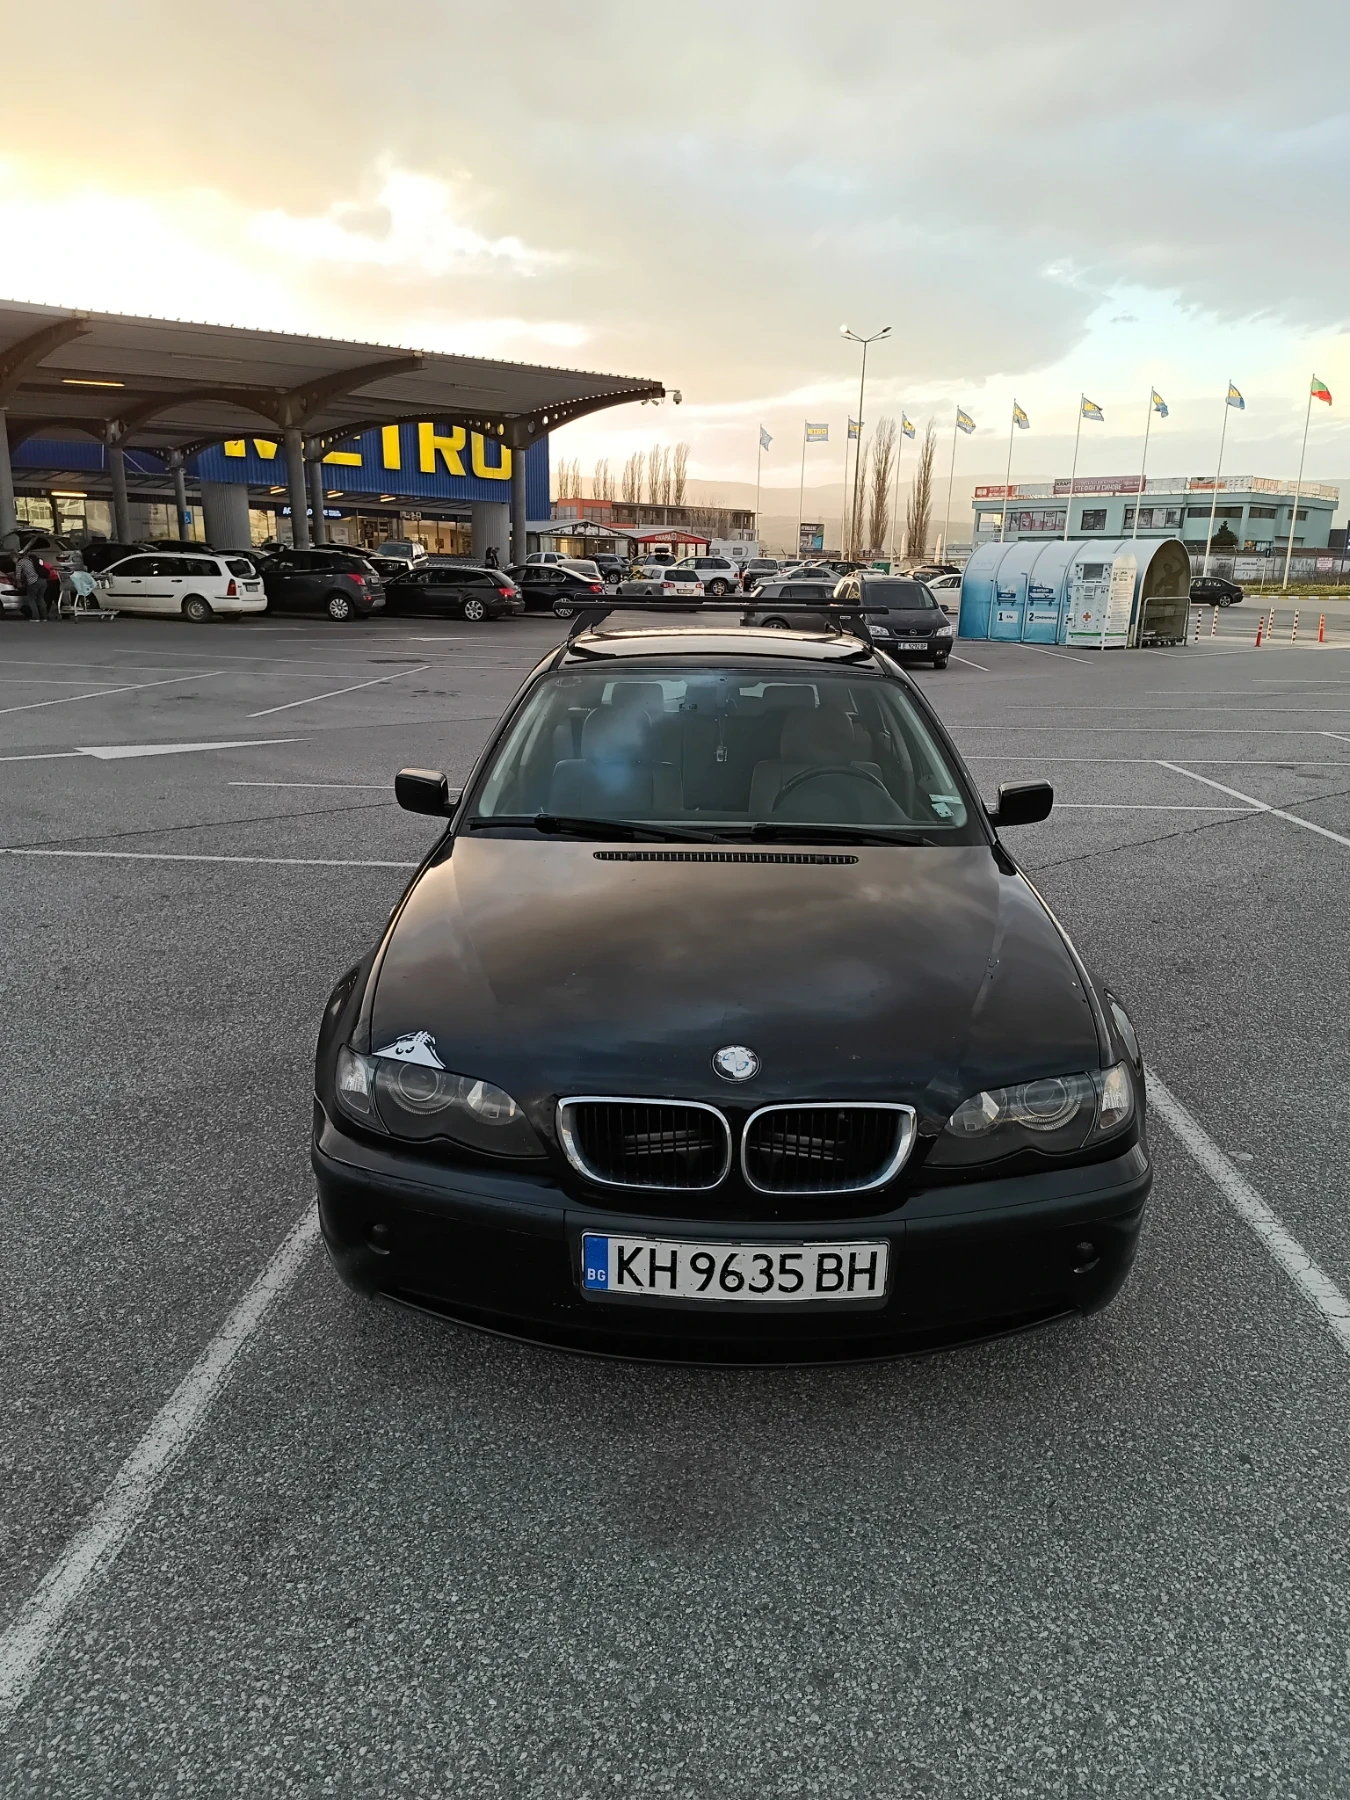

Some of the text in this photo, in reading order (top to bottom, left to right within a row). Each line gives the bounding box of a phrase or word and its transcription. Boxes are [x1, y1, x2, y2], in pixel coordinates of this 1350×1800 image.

[998, 612, 1003, 621] 1
[1028, 612, 1034, 622] 2
[587, 1268, 606, 1281] BG
[617, 1245, 878, 1293] KH 9635 BH
